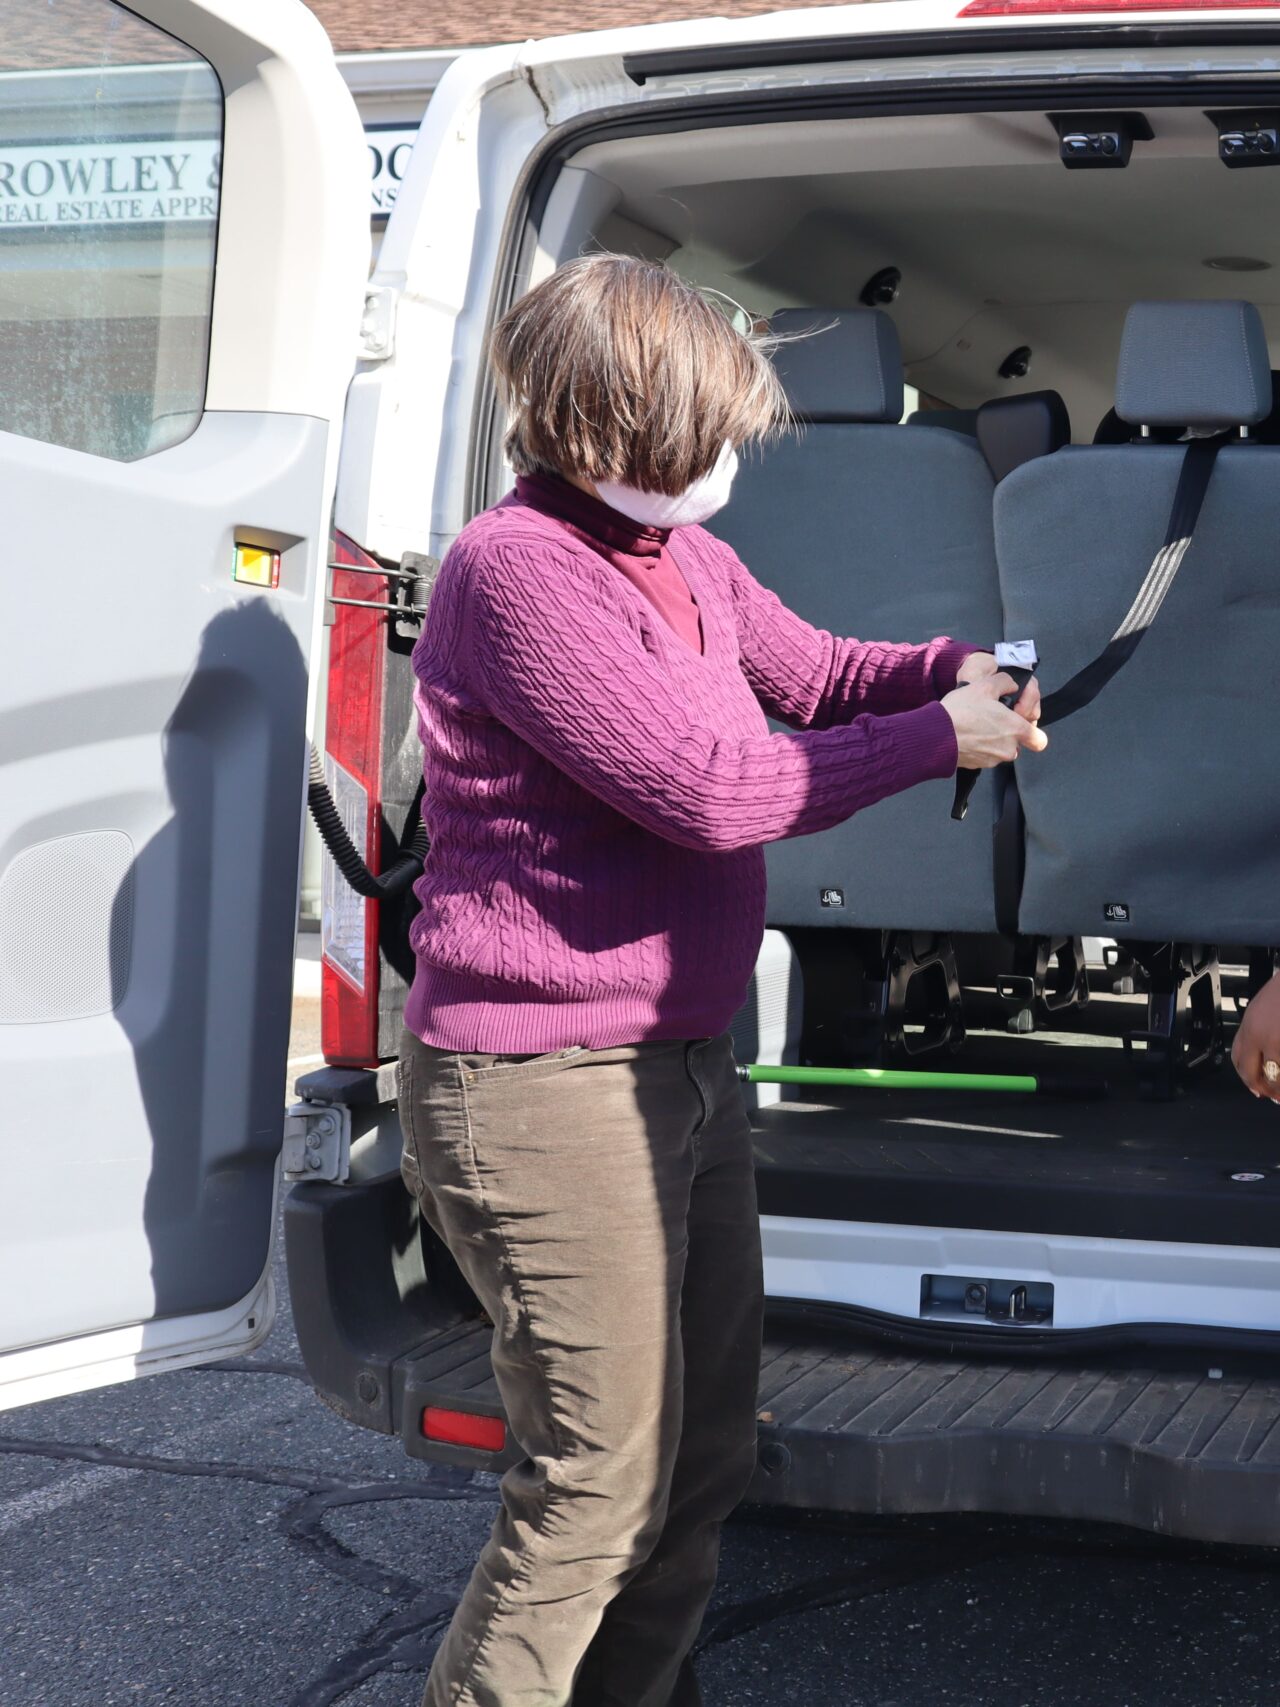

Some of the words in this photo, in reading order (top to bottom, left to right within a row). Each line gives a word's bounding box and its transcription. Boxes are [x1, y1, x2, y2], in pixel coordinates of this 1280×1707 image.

[0, 153, 191, 198] ROWLEY
[0, 203, 48, 222] EAL
[57, 199, 143, 221] ESTATE
[150, 196, 215, 217] APPR
